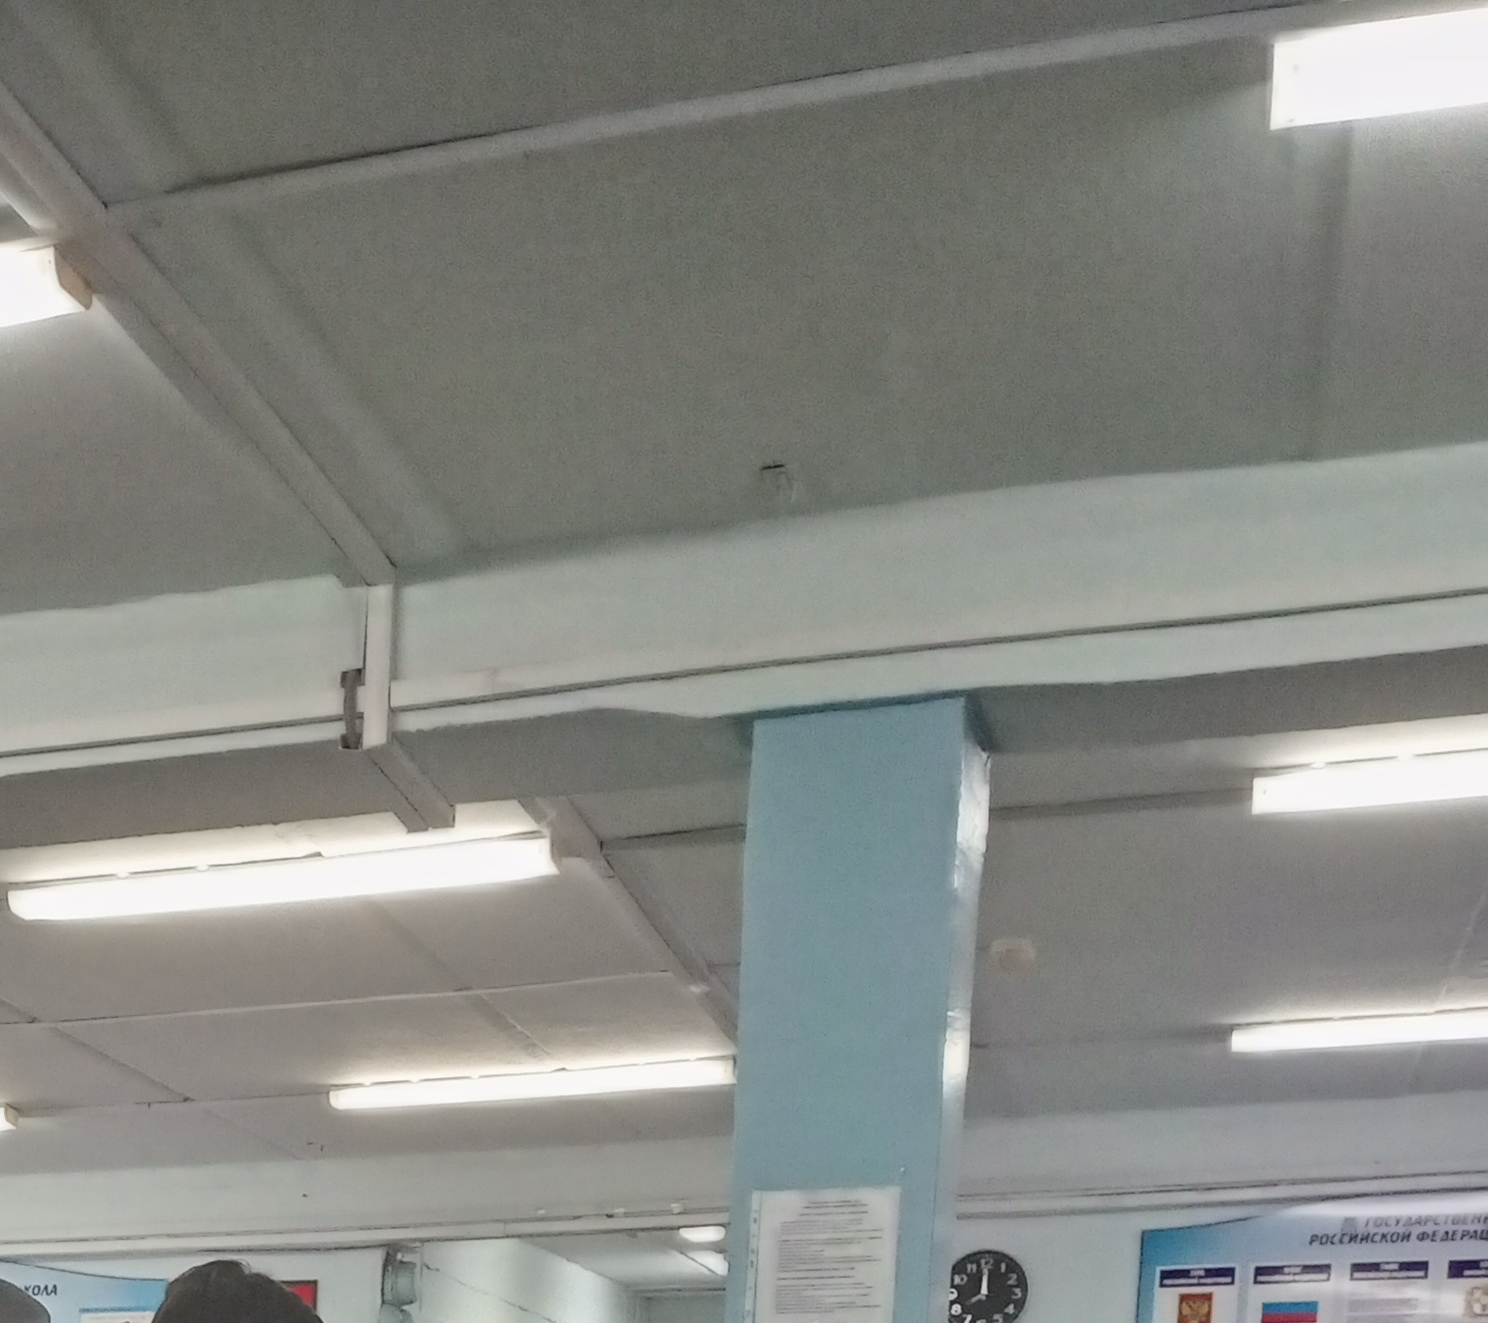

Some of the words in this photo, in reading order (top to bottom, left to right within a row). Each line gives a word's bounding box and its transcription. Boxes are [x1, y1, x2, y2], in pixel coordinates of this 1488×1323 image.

[1309, 1229, 1411, 1245] РОССИЙСКОЙ
[1416, 1228, 1488, 1244] ФЕДЕРАЦ
[966, 1263, 977, 1274] 11
[980, 1258, 993, 1269] 12
[1000, 1262, 1006, 1273] 1
[953, 1274, 968, 1286] 10
[1007, 1273, 1018, 1285] 2
[1011, 1287, 1022, 1299] 3
[951, 1303, 962, 1316] 8
[1004, 1303, 1015, 1314] 4
